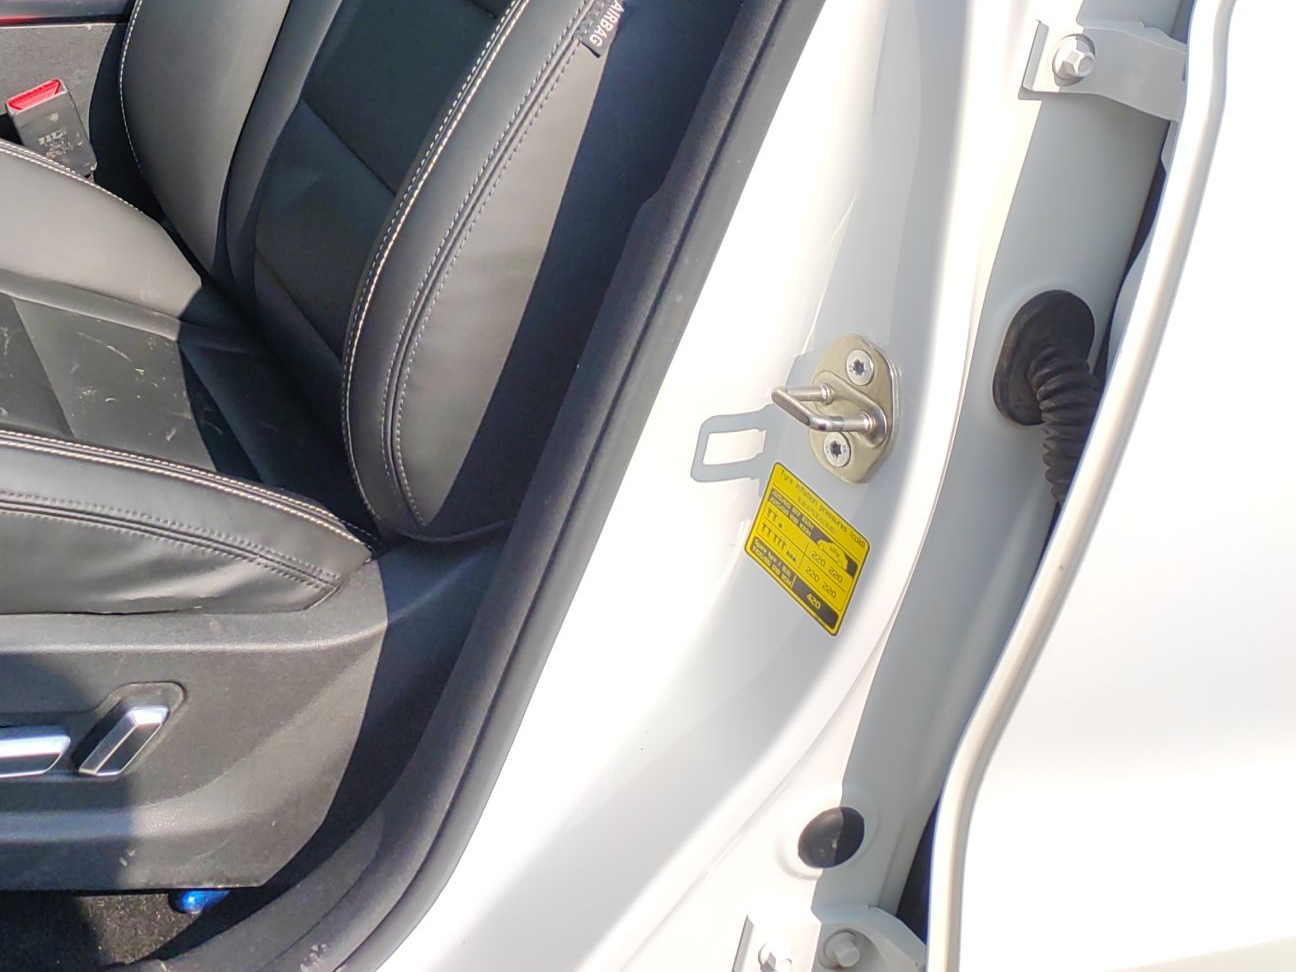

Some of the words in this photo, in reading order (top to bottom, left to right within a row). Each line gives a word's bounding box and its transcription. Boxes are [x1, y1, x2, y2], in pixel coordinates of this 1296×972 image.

[589, 0, 624, 46] AIRBAG
[819, 505, 847, 533] pressures
[806, 567, 819, 582] 220
[822, 582, 836, 598] 220
[811, 551, 825, 567] 220
[828, 567, 842, 583] 220
[807, 593, 820, 610] 420
